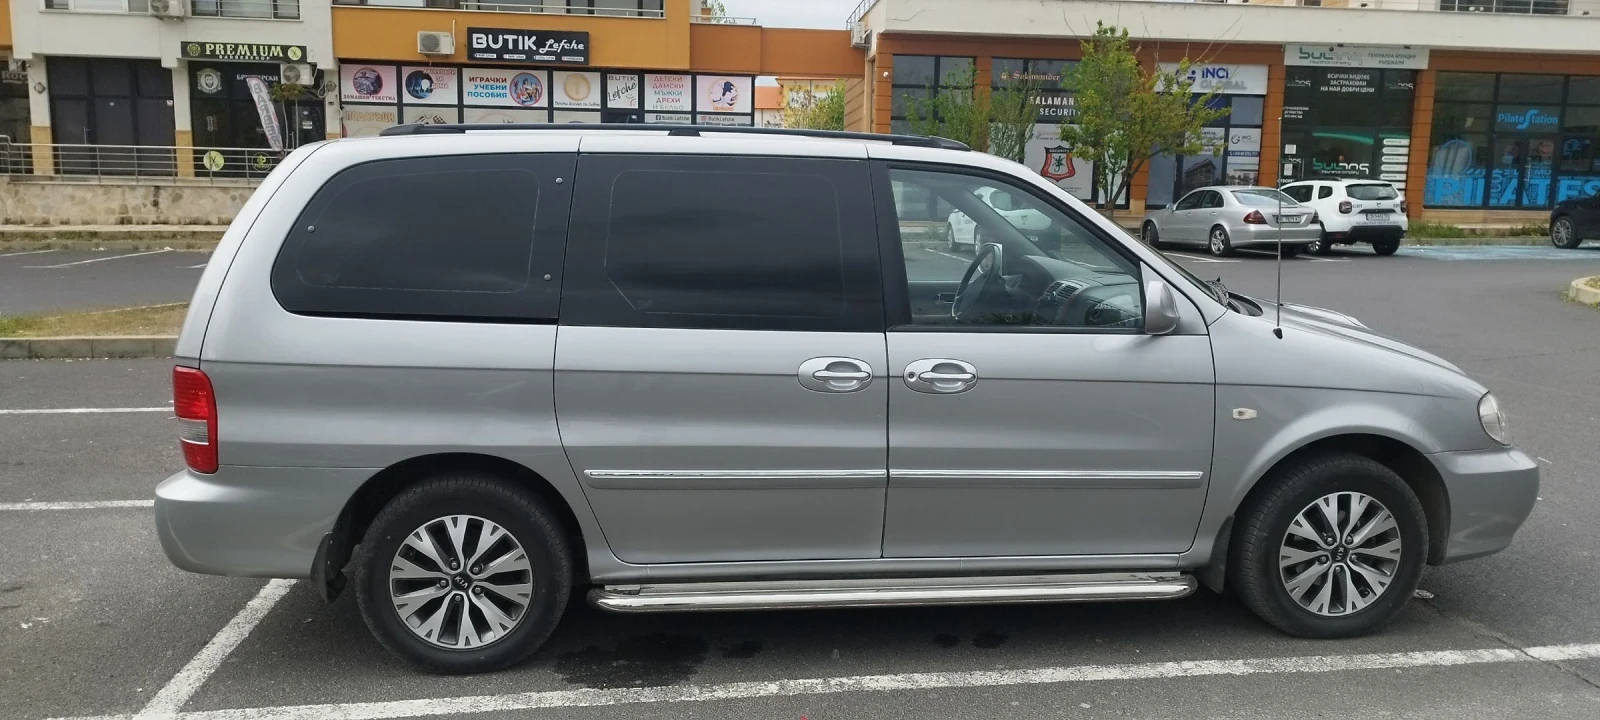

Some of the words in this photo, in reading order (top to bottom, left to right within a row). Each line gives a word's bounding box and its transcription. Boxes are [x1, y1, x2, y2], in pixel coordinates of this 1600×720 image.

[205, 43, 284, 57] PREMIUM
[472, 33, 537, 50] BUTIK
[539, 38, 585, 54] Lefche
[1029, 96, 1088, 107] SALAMAN
[454, 576, 468, 589] KIA
